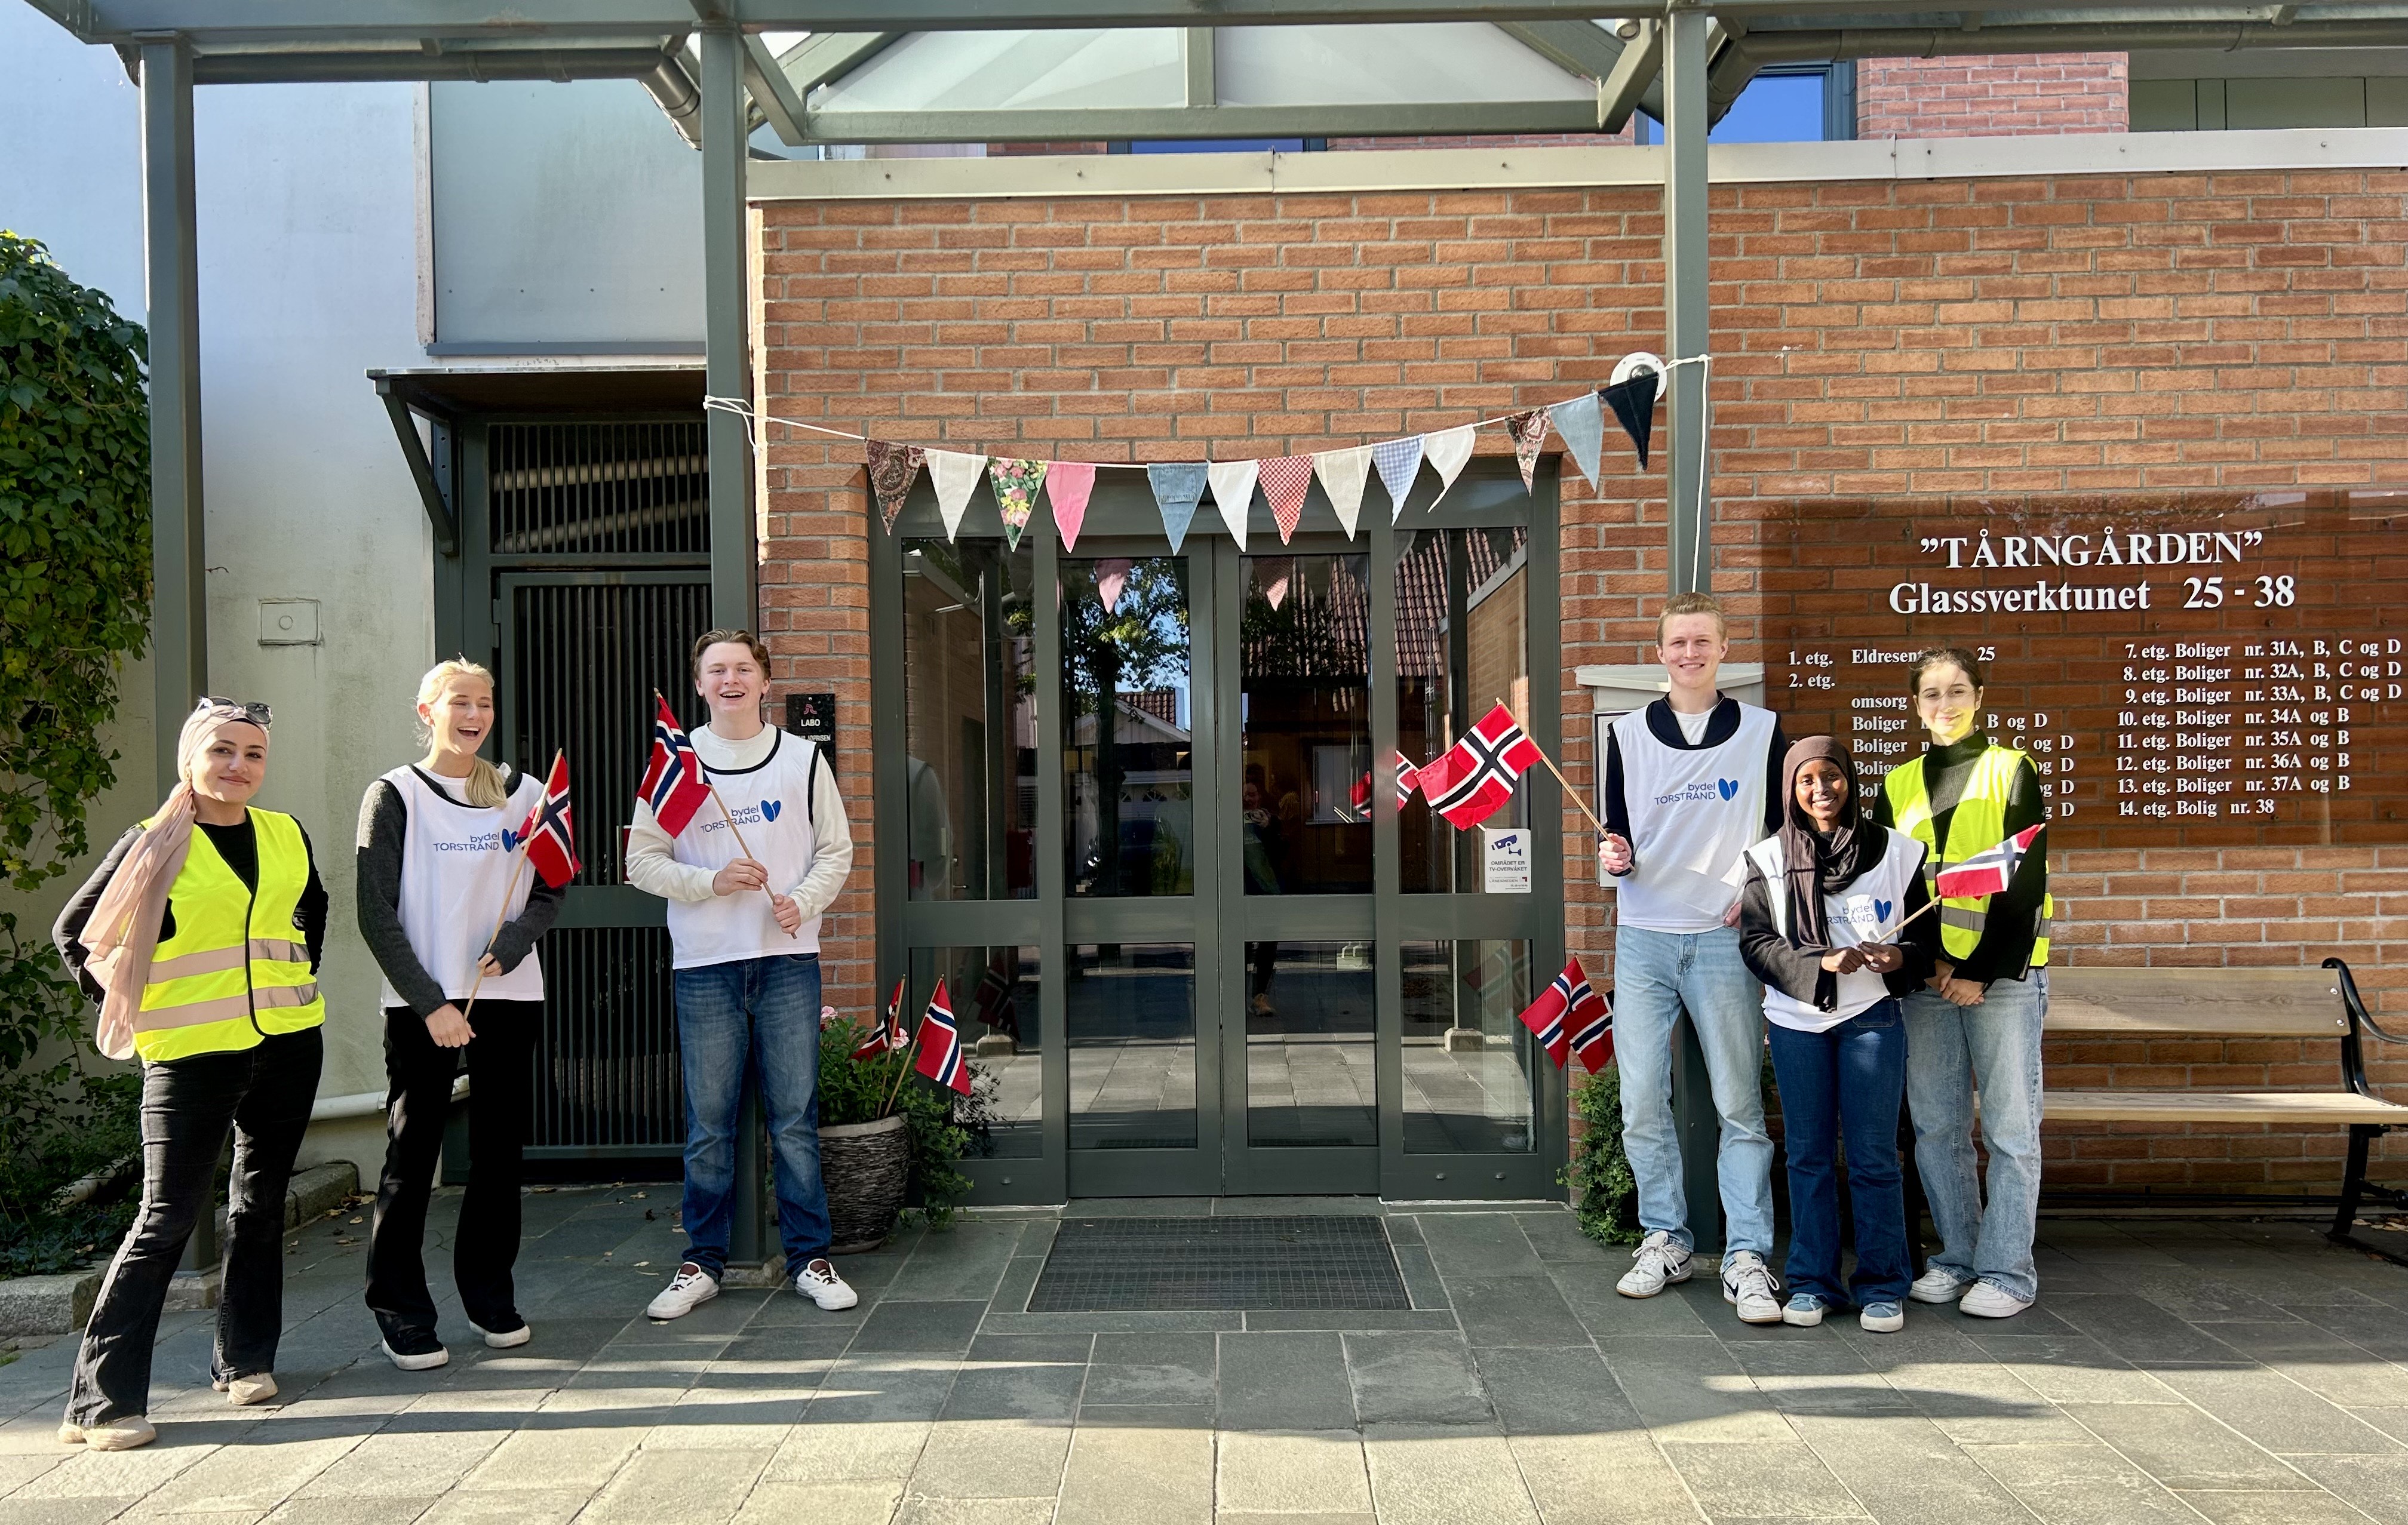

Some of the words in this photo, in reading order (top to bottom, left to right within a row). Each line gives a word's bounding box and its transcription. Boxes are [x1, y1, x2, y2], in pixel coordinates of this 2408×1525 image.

[1889, 580, 2151, 614] Glassverktunet
[2183, 577, 2223, 608] 25
[2254, 575, 2295, 607] 38
[1789, 650, 1801, 665] 1.
[1805, 651, 1833, 668] etg.
[1851, 648, 1923, 663] Eldresent
[1977, 646, 1995, 661] 25
[2125, 644, 2137, 659] 7.
[2141, 644, 2170, 661] etg.
[2174, 642, 2231, 660] Boliger
[2244, 645, 2265, 656] nr.
[2269, 641, 2304, 659] 31A,
[2313, 640, 2330, 658] B,
[2339, 639, 2352, 654] C
[2360, 643, 2379, 657] og
[2387, 639, 2401, 654] D
[1789, 673, 1803, 687] 2.
[1807, 674, 1835, 690] etg.
[2123, 666, 2137, 681] 8.
[2142, 667, 2170, 684] etg.
[2175, 665, 2231, 682] Boliger
[2244, 668, 2265, 679] nr.
[2269, 663, 2305, 681] 32A,
[2313, 663, 2330, 680] B,
[2339, 662, 2352, 677] C
[2360, 666, 2379, 680] og
[2387, 662, 2401, 676] D
[2126, 688, 2137, 704] 9.
[2142, 689, 2170, 706] etg.
[2175, 687, 2231, 705] Boliger
[2244, 690, 2265, 702] nr.
[2270, 685, 2305, 703] 33A,
[2314, 685, 2332, 703] B,
[2340, 684, 2353, 700] C
[2360, 688, 2380, 702] og
[2388, 684, 2402, 699] D
[1851, 697, 1908, 711] omsorg
[801, 718, 821, 727] LABO
[1852, 716, 1908, 733] Boliger
[1986, 714, 1999, 728] B
[2007, 717, 2026, 731] og
[2034, 713, 2048, 727] D
[2118, 711, 2138, 726] 10.
[2142, 712, 2170, 728] etg.
[2175, 710, 2232, 728] Boliger
[2245, 713, 2265, 724] nr.
[2270, 708, 2302, 724] 34A
[2309, 712, 2329, 725] og
[2337, 707, 2349, 722] B
[1853, 738, 1908, 755] Boliger
[2012, 736, 2025, 750] C
[2033, 739, 2052, 753] og
[2060, 735, 2074, 749] D
[2118, 733, 2137, 748] 11.
[2142, 734, 2170, 751] etg.
[2175, 732, 2232, 750] Boliger
[2245, 735, 2265, 746] nr.
[2270, 731, 2302, 746] 35A
[2310, 734, 2329, 748] og
[2337, 730, 2349, 745] B
[2060, 757, 2074, 772] D
[2116, 756, 2138, 771] 12.
[2142, 757, 2171, 773] etg.
[2176, 755, 2232, 773] Boliger
[2246, 758, 2265, 768] nr.
[2271, 753, 2302, 768] 36A
[2310, 757, 2329, 771] og
[2338, 752, 2349, 767] B
[1688, 782, 1716, 792] bydel
[2060, 779, 2075, 794] D
[2118, 779, 2138, 794] 13.
[2142, 779, 2171, 795] etg.
[2176, 777, 2232, 795] Boliger
[2246, 780, 2266, 791] nr.
[2271, 776, 2302, 791] 37A
[2310, 779, 2330, 793] og
[2338, 775, 2350, 790] B
[1654, 792, 1716, 805] TORSTRAND
[731, 805, 760, 817] bydel
[2060, 802, 2075, 816] D
[2119, 801, 2139, 816] 14.
[2143, 801, 2171, 818] etg.
[2176, 800, 2217, 817] Bolig
[2230, 803, 2250, 814] nr.
[2255, 798, 2275, 814] 38
[433, 842, 499, 851] TORSTRAND
[469, 832, 500, 844] bydel
[1842, 903, 1873, 915] bydel
[1827, 914, 1875, 925] RSTRAND
